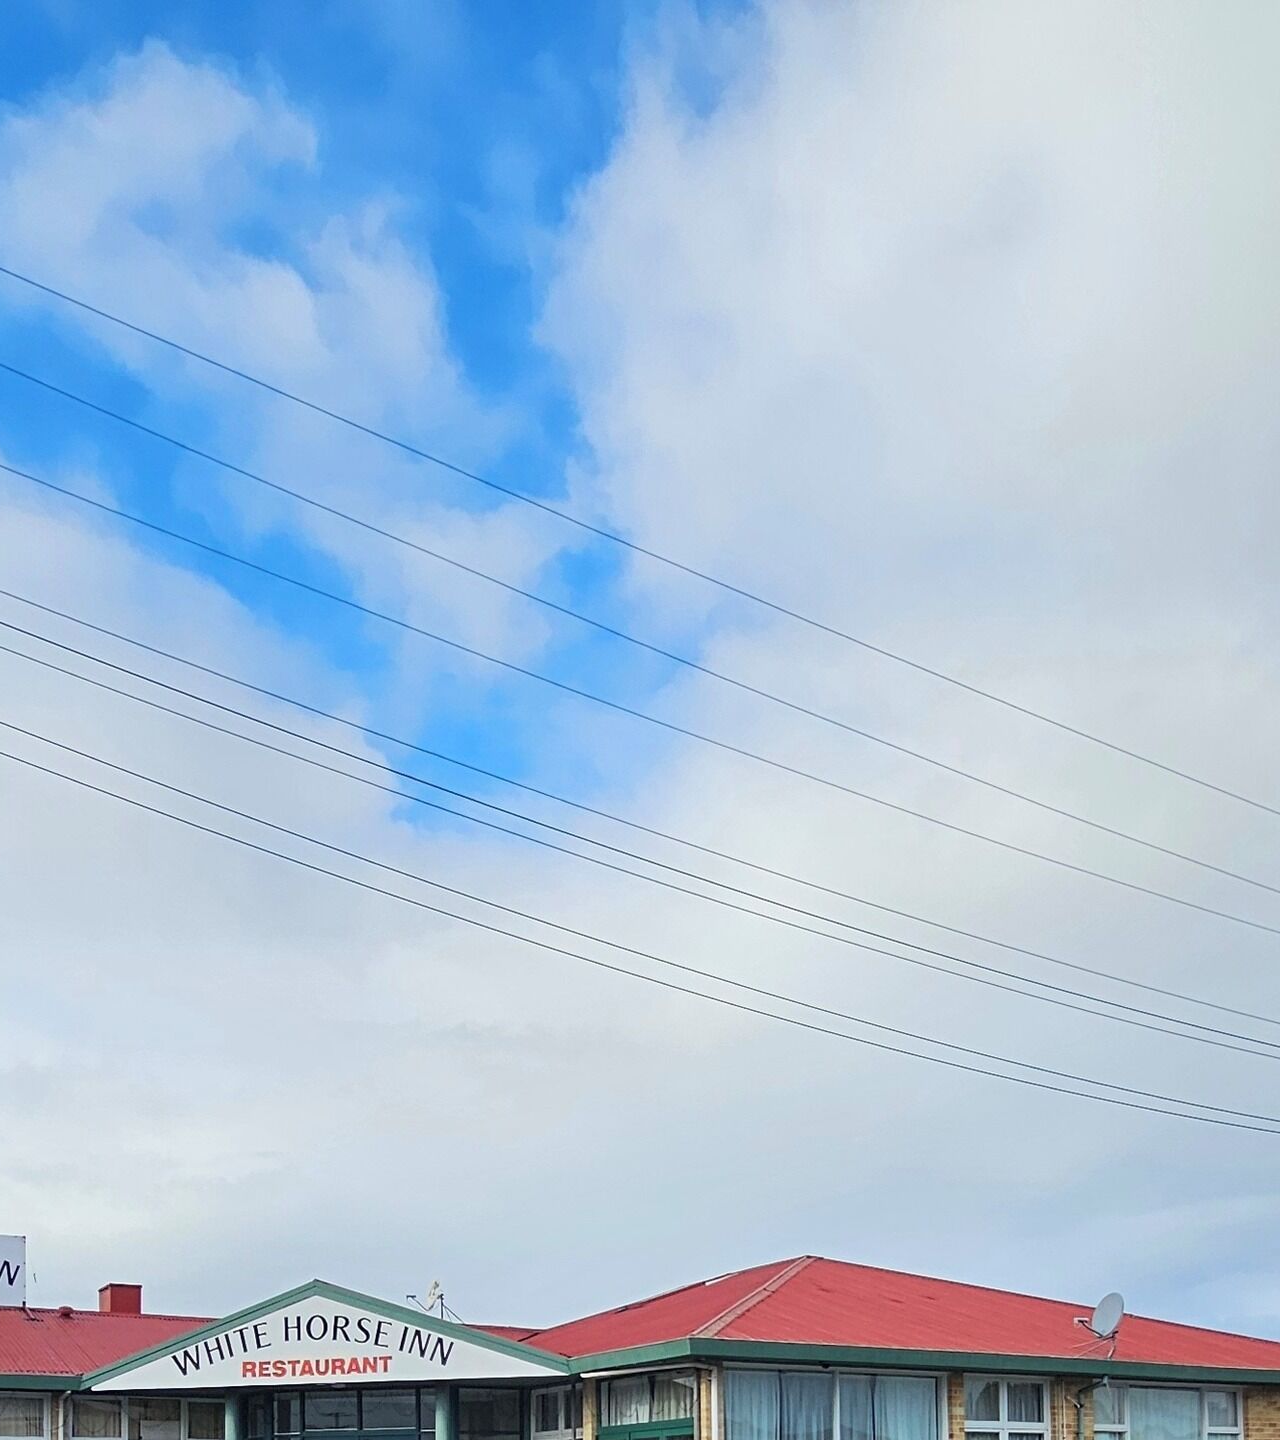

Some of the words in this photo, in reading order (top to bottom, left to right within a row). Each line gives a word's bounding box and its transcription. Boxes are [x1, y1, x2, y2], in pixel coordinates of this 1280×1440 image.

[172, 1321, 271, 1376] WHITE
[283, 1314, 393, 1348] HORSE
[398, 1326, 455, 1366] INN
[242, 1356, 393, 1378] RESTAURANT
